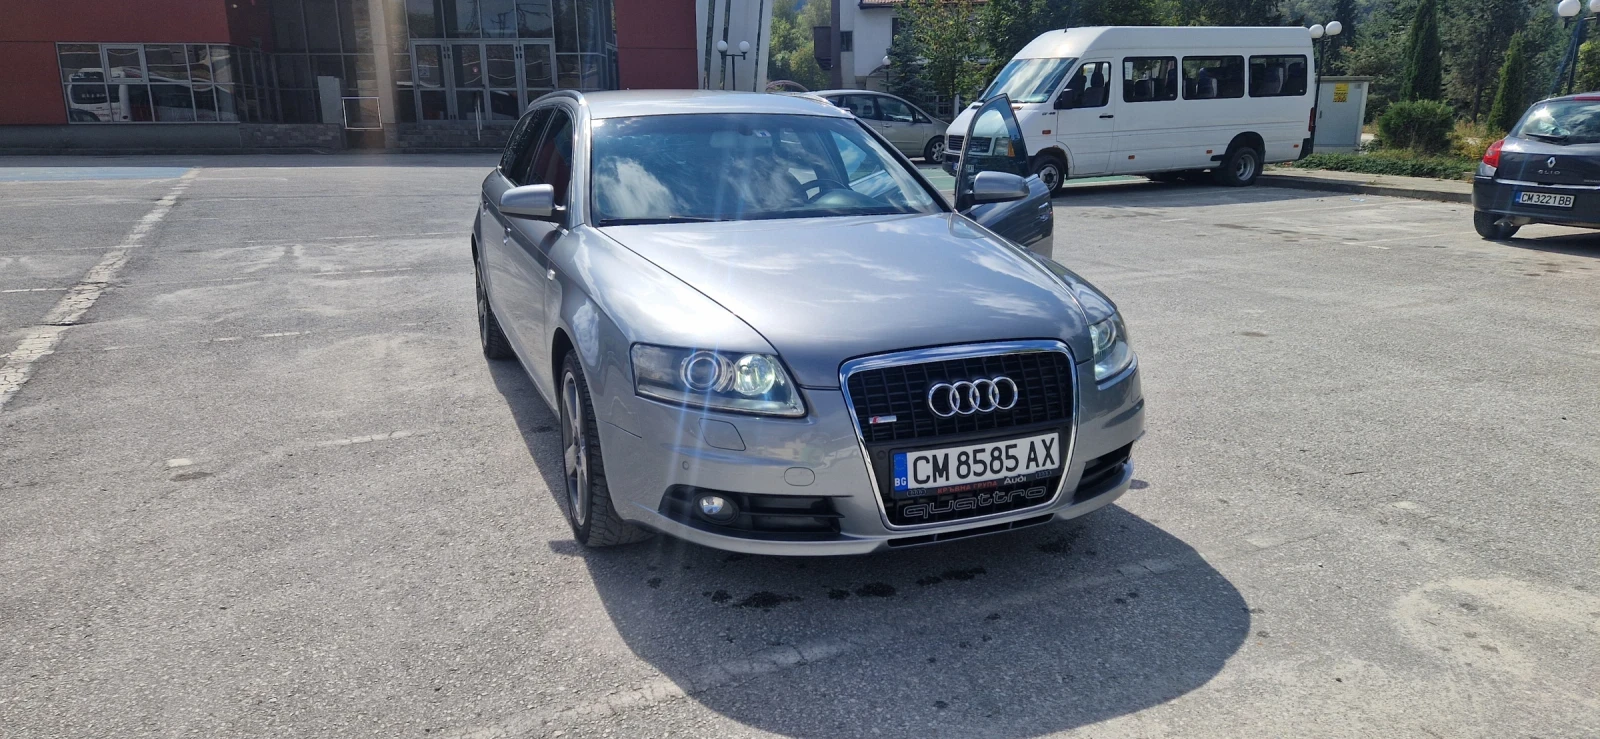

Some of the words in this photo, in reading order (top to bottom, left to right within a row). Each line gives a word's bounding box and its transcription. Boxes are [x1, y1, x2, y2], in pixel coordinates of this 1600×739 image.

[1521, 193, 1533, 203] CM
[1534, 194, 1557, 204] 3221
[1558, 196, 1572, 206] BB
[913, 453, 950, 485] CM
[956, 443, 1019, 479] 8585
[1026, 437, 1055, 470] AX
[894, 477, 907, 487] BG
[937, 484, 972, 494] КРЪВНА
[973, 480, 998, 490] ГРУПА
[1003, 476, 1027, 486] Audi
[904, 486, 1046, 519] quattro
